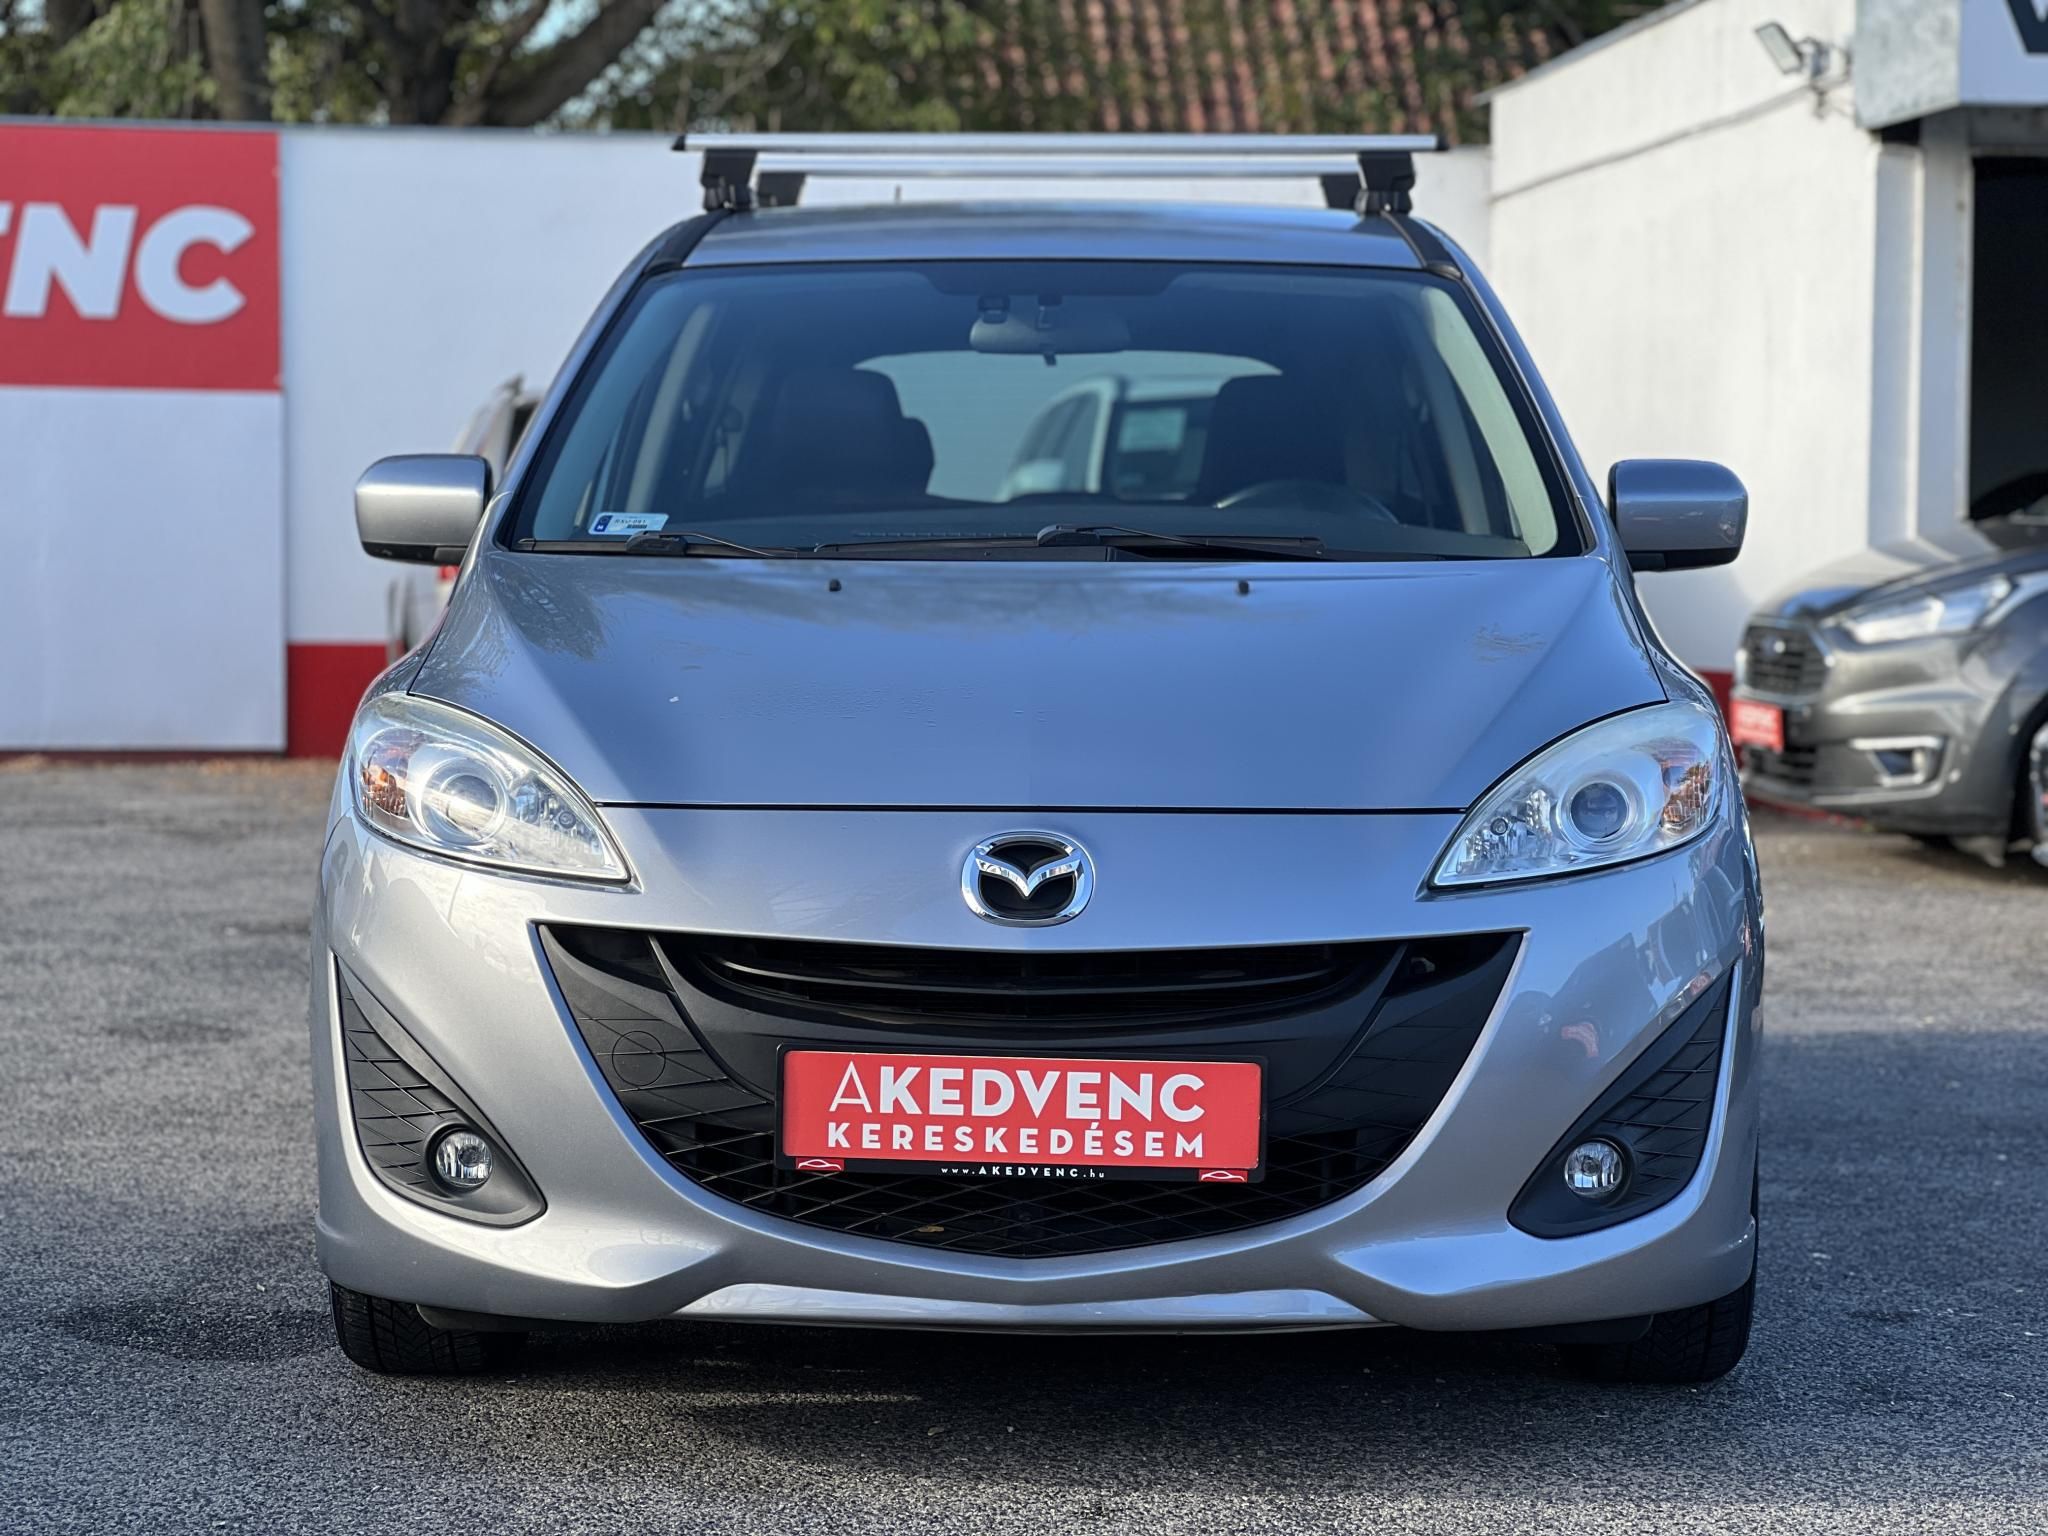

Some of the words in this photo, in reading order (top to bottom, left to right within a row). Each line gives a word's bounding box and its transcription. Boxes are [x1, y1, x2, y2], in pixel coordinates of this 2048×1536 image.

[0, 201, 255, 324] NC
[827, 1121, 1204, 1159] KERESKEDÉSEM
[940, 1165, 1105, 1179] www.AKEDVENC.hu
